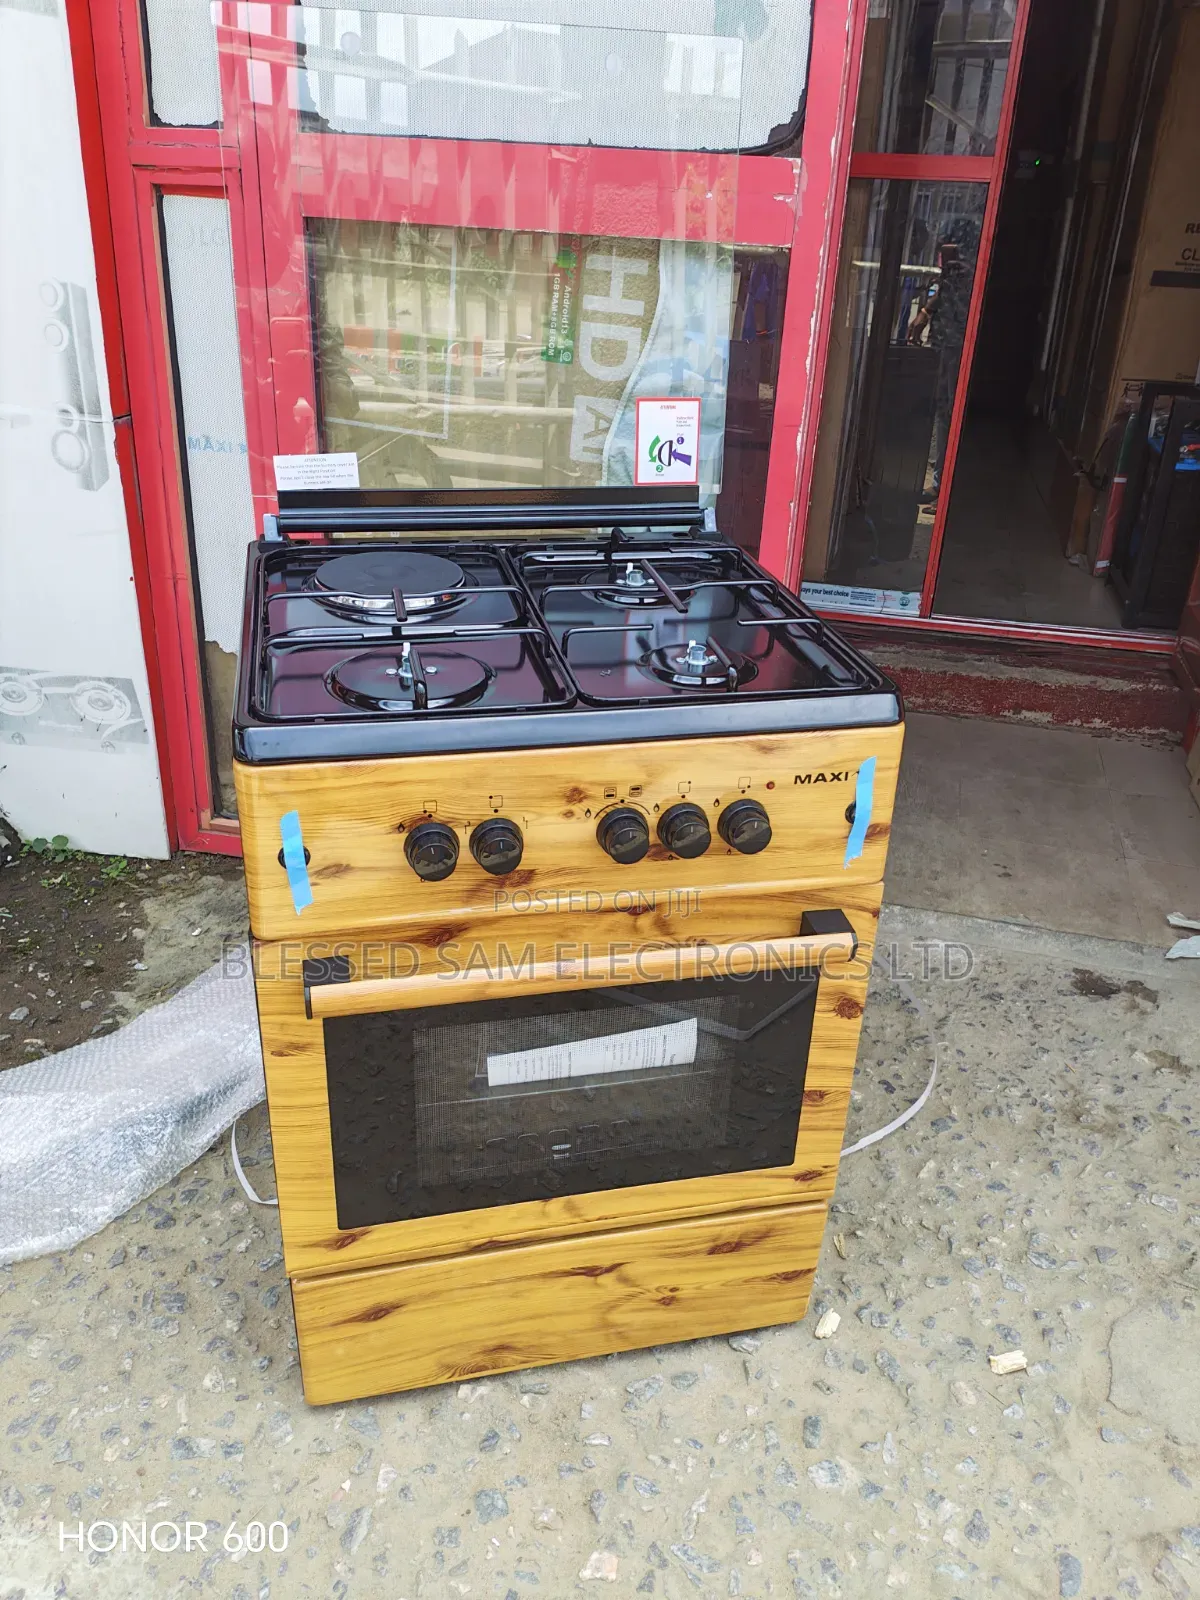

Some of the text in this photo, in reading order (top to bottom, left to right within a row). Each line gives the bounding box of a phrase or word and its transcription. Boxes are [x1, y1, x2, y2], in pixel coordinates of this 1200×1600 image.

[553, 272, 561, 290] 1GB
[561, 285, 572, 335] Android13
[578, 254, 649, 382] HD
[548, 335, 557, 356] ROM
[822, 588, 834, 596] best
[833, 589, 850, 598] choice
[793, 771, 849, 785] MAXI
